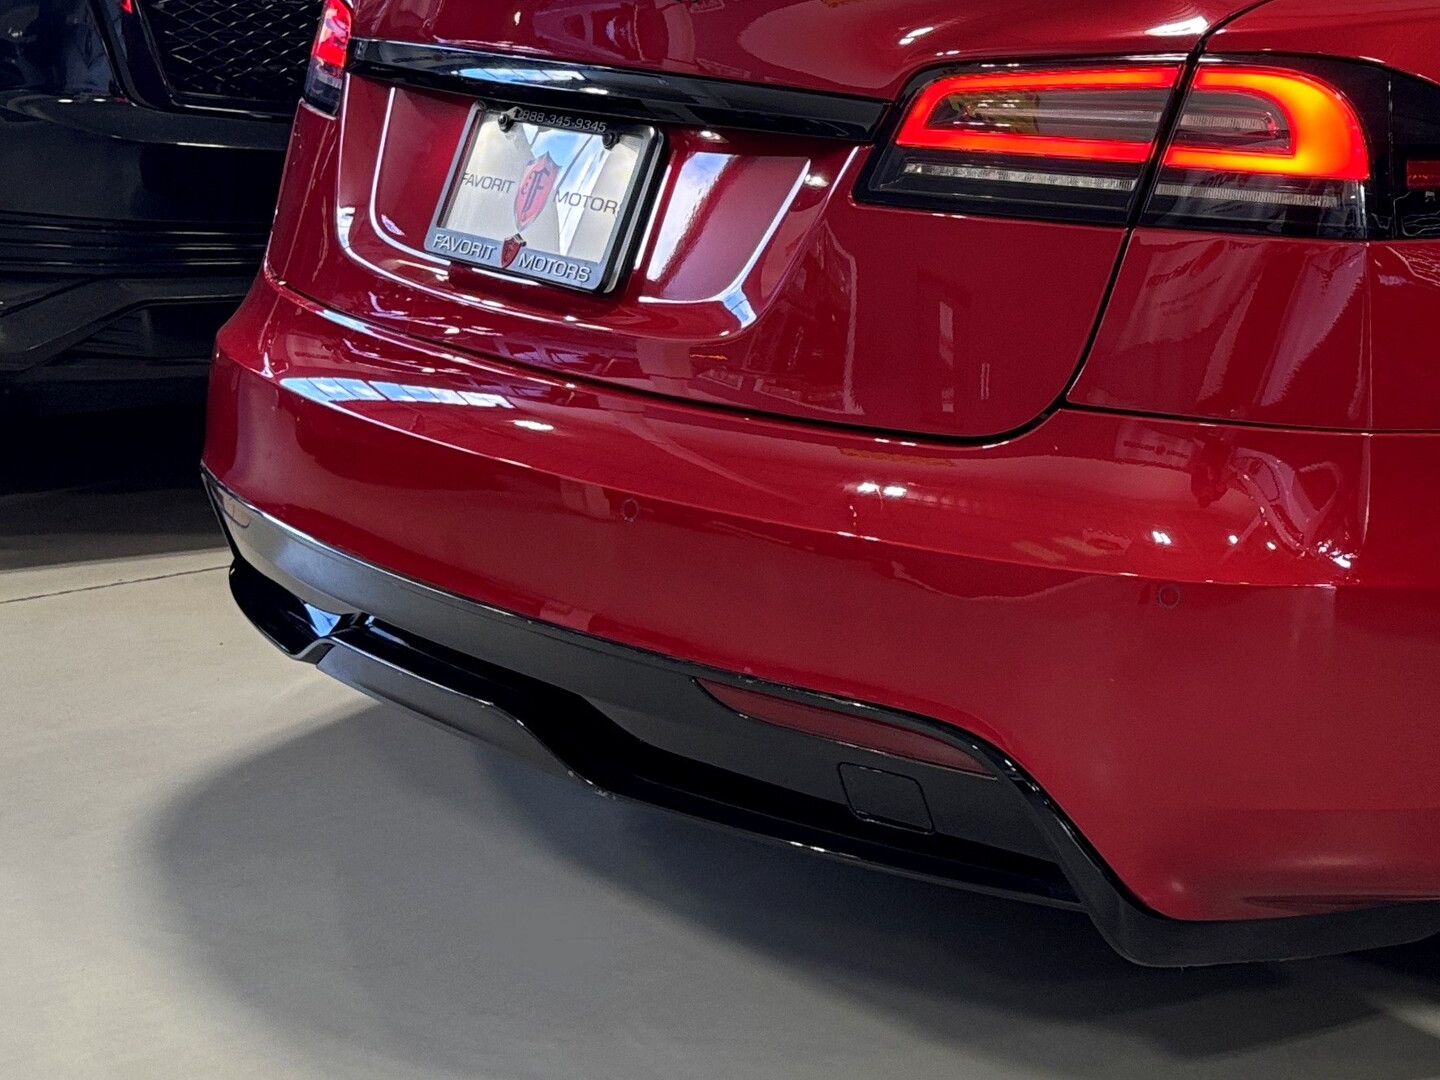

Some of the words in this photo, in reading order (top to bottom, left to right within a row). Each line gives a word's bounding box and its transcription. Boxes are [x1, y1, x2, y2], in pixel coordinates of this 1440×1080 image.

[555, 190, 619, 216] MOTOR
[432, 233, 498, 261] FAVORIT
[518, 251, 592, 283] MOTORS
